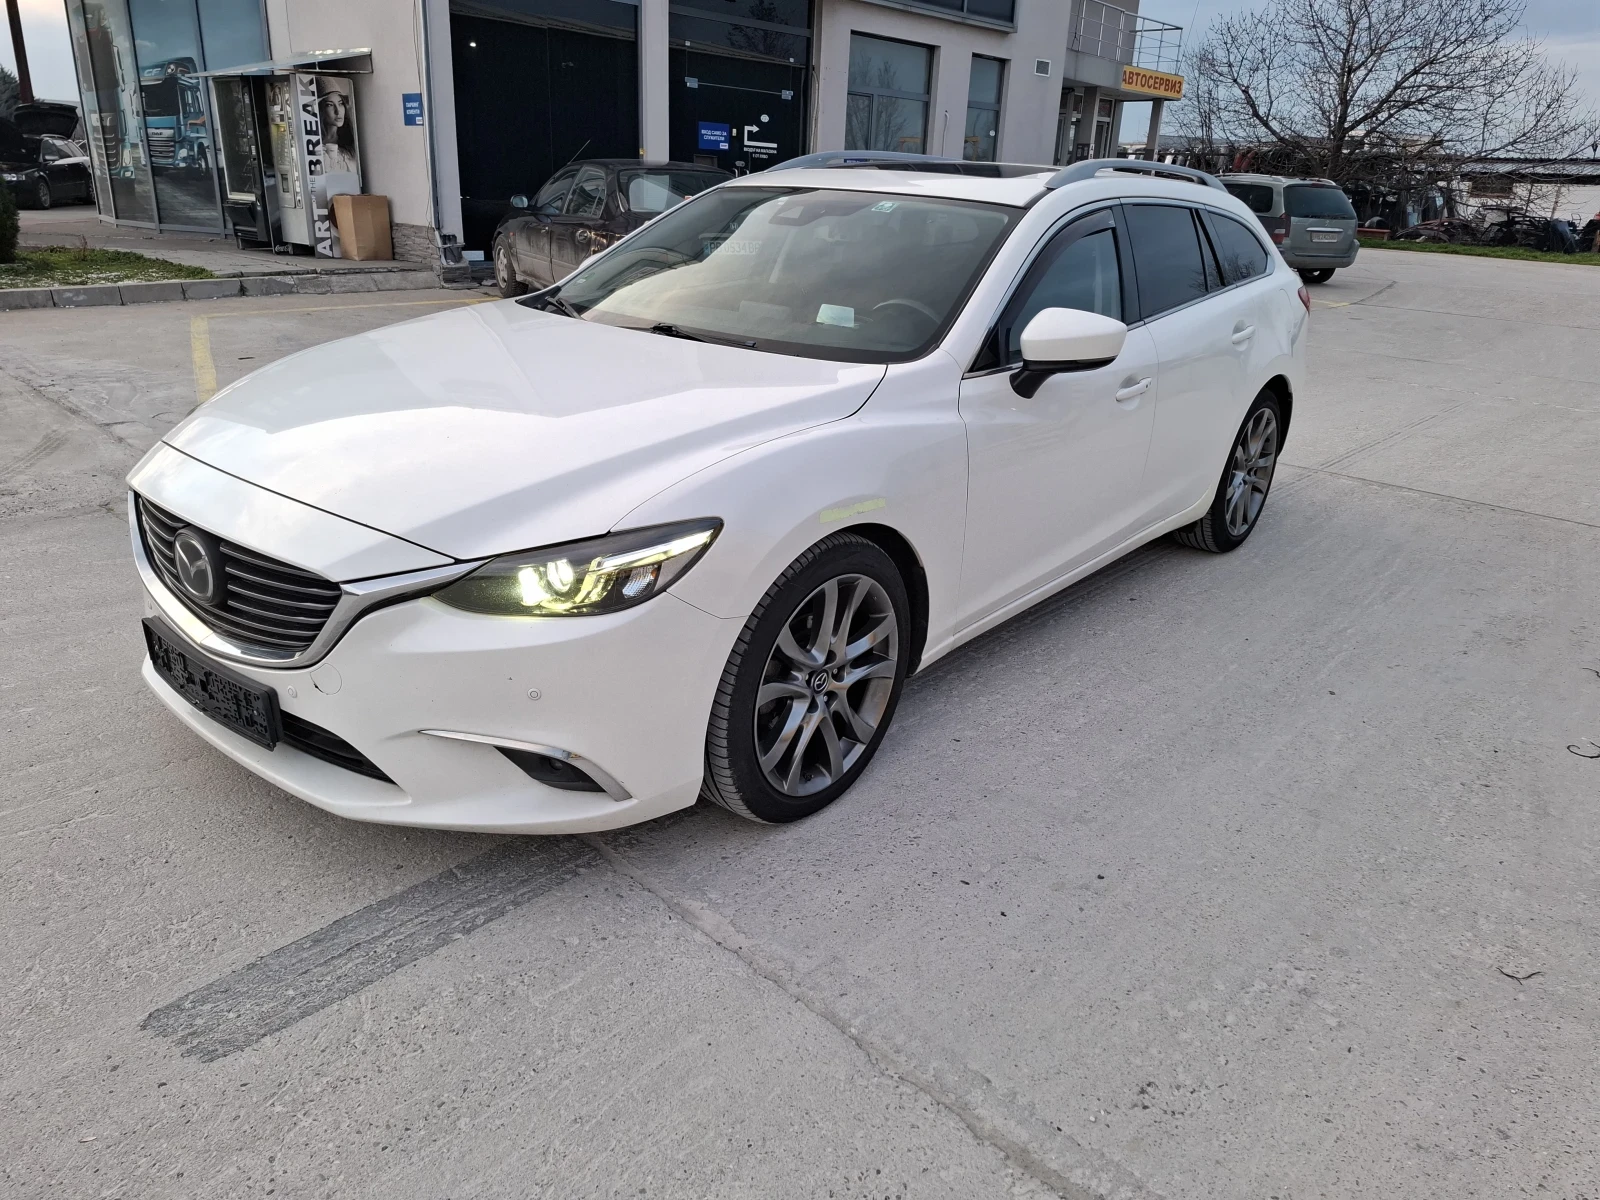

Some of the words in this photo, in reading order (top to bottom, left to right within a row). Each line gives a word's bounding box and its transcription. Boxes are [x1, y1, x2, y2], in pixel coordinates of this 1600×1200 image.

[144, 68, 161, 76] CF
[1122, 70, 1183, 94] АВТОСЕРВИЗ
[298, 76, 324, 177] BREAK
[309, 177, 317, 194] THE
[312, 201, 333, 258] ART
